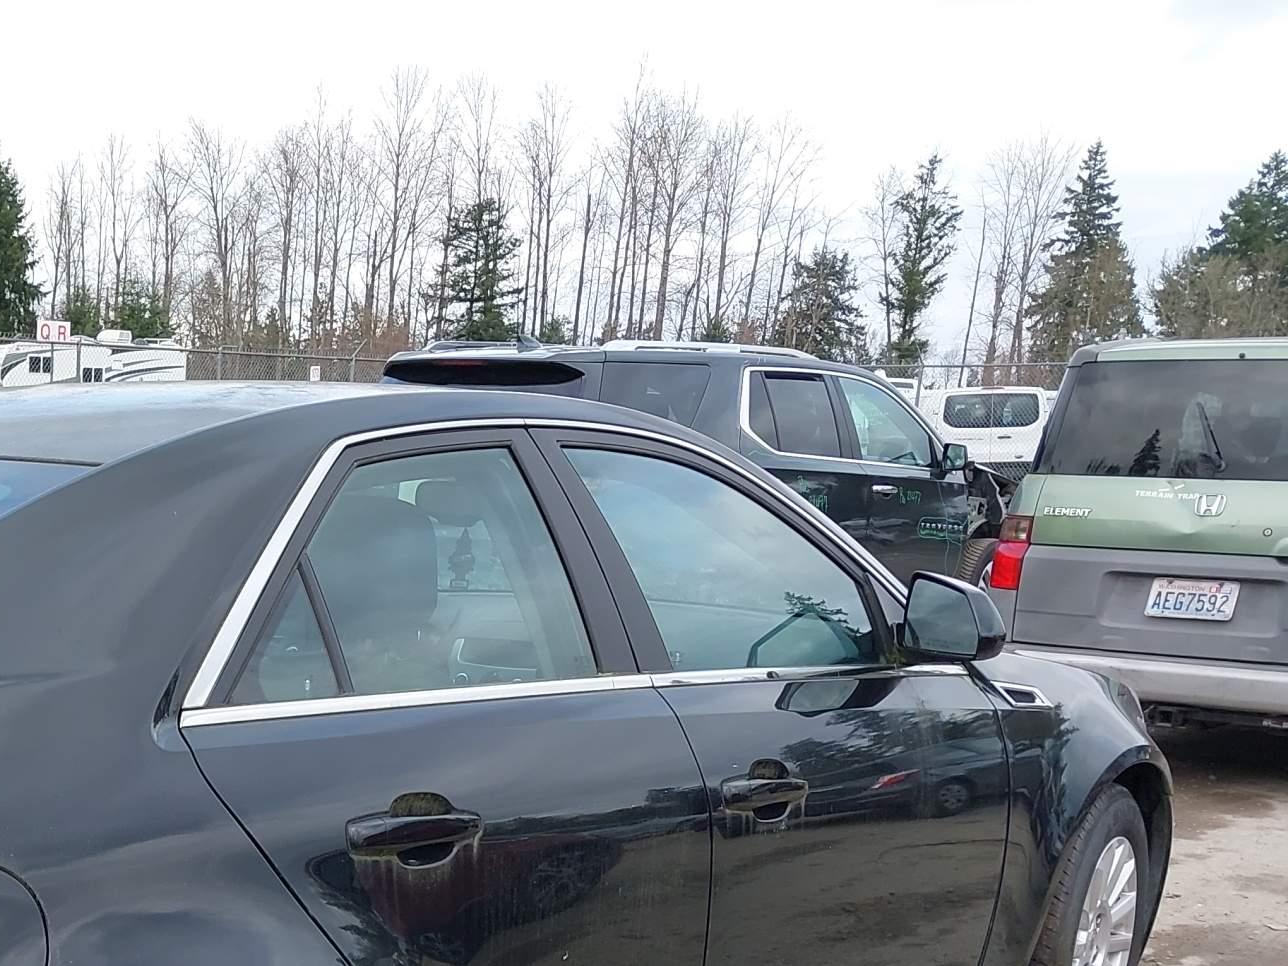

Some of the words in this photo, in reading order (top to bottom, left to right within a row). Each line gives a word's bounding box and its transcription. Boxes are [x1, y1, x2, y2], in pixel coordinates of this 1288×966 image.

[40, 323, 51, 340] Q
[58, 325, 66, 341] R
[1135, 490, 1174, 499] TERRAIN
[1043, 506, 1091, 517] ELEMENT
[1152, 591, 1229, 613] AEG7592
